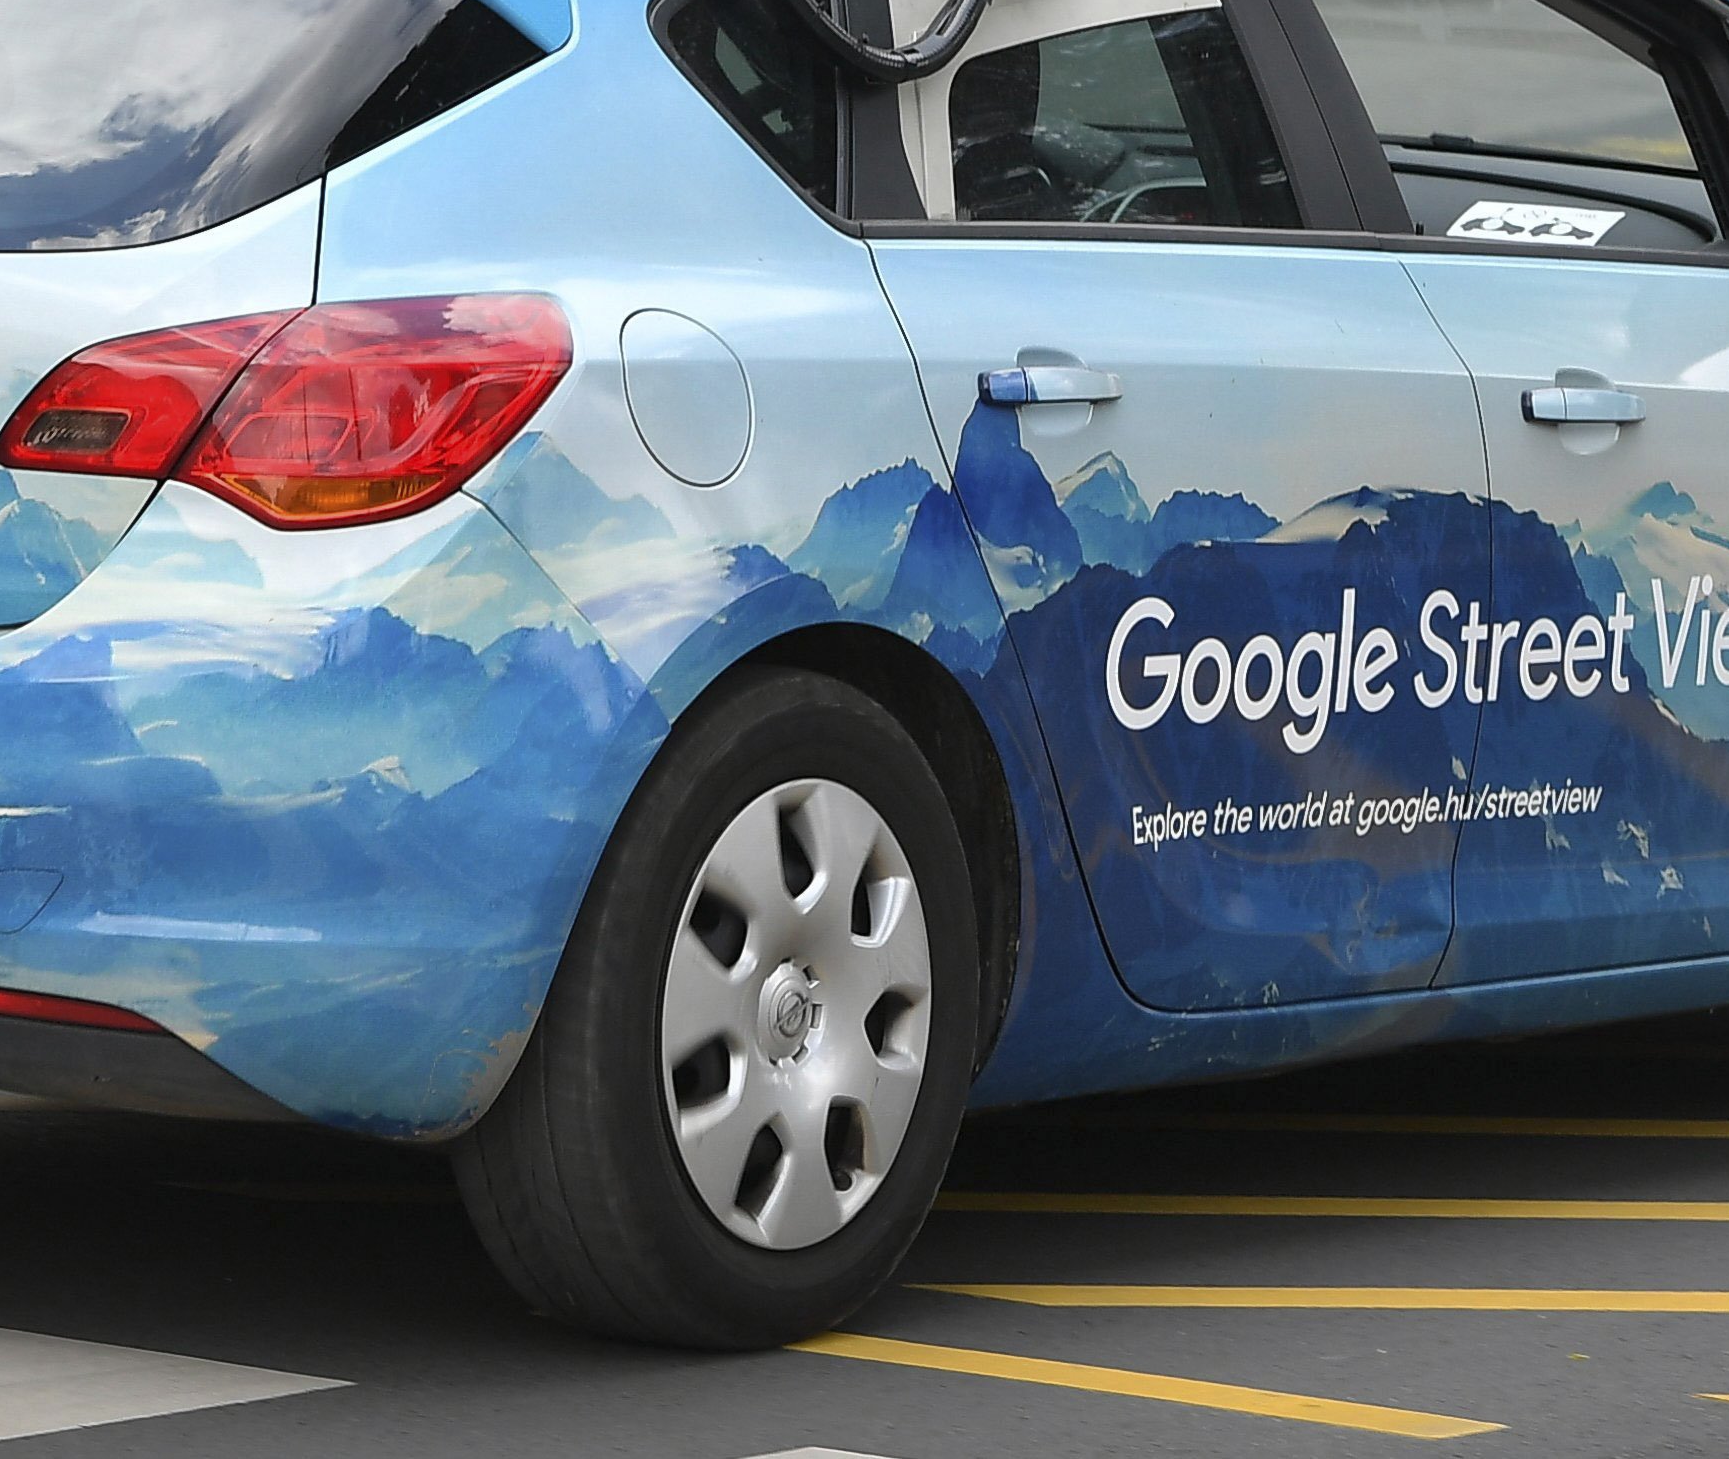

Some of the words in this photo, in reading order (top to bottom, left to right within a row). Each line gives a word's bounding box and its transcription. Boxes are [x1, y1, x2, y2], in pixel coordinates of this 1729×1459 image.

[1106, 587, 1399, 754] Google
[1413, 589, 1634, 709] Street
[1132, 801, 1207, 852] Explore
[1213, 797, 1253, 835] the
[1259, 790, 1328, 832] world
[1328, 791, 1355, 827] at
[1355, 778, 1603, 837] google.hu/streetview
